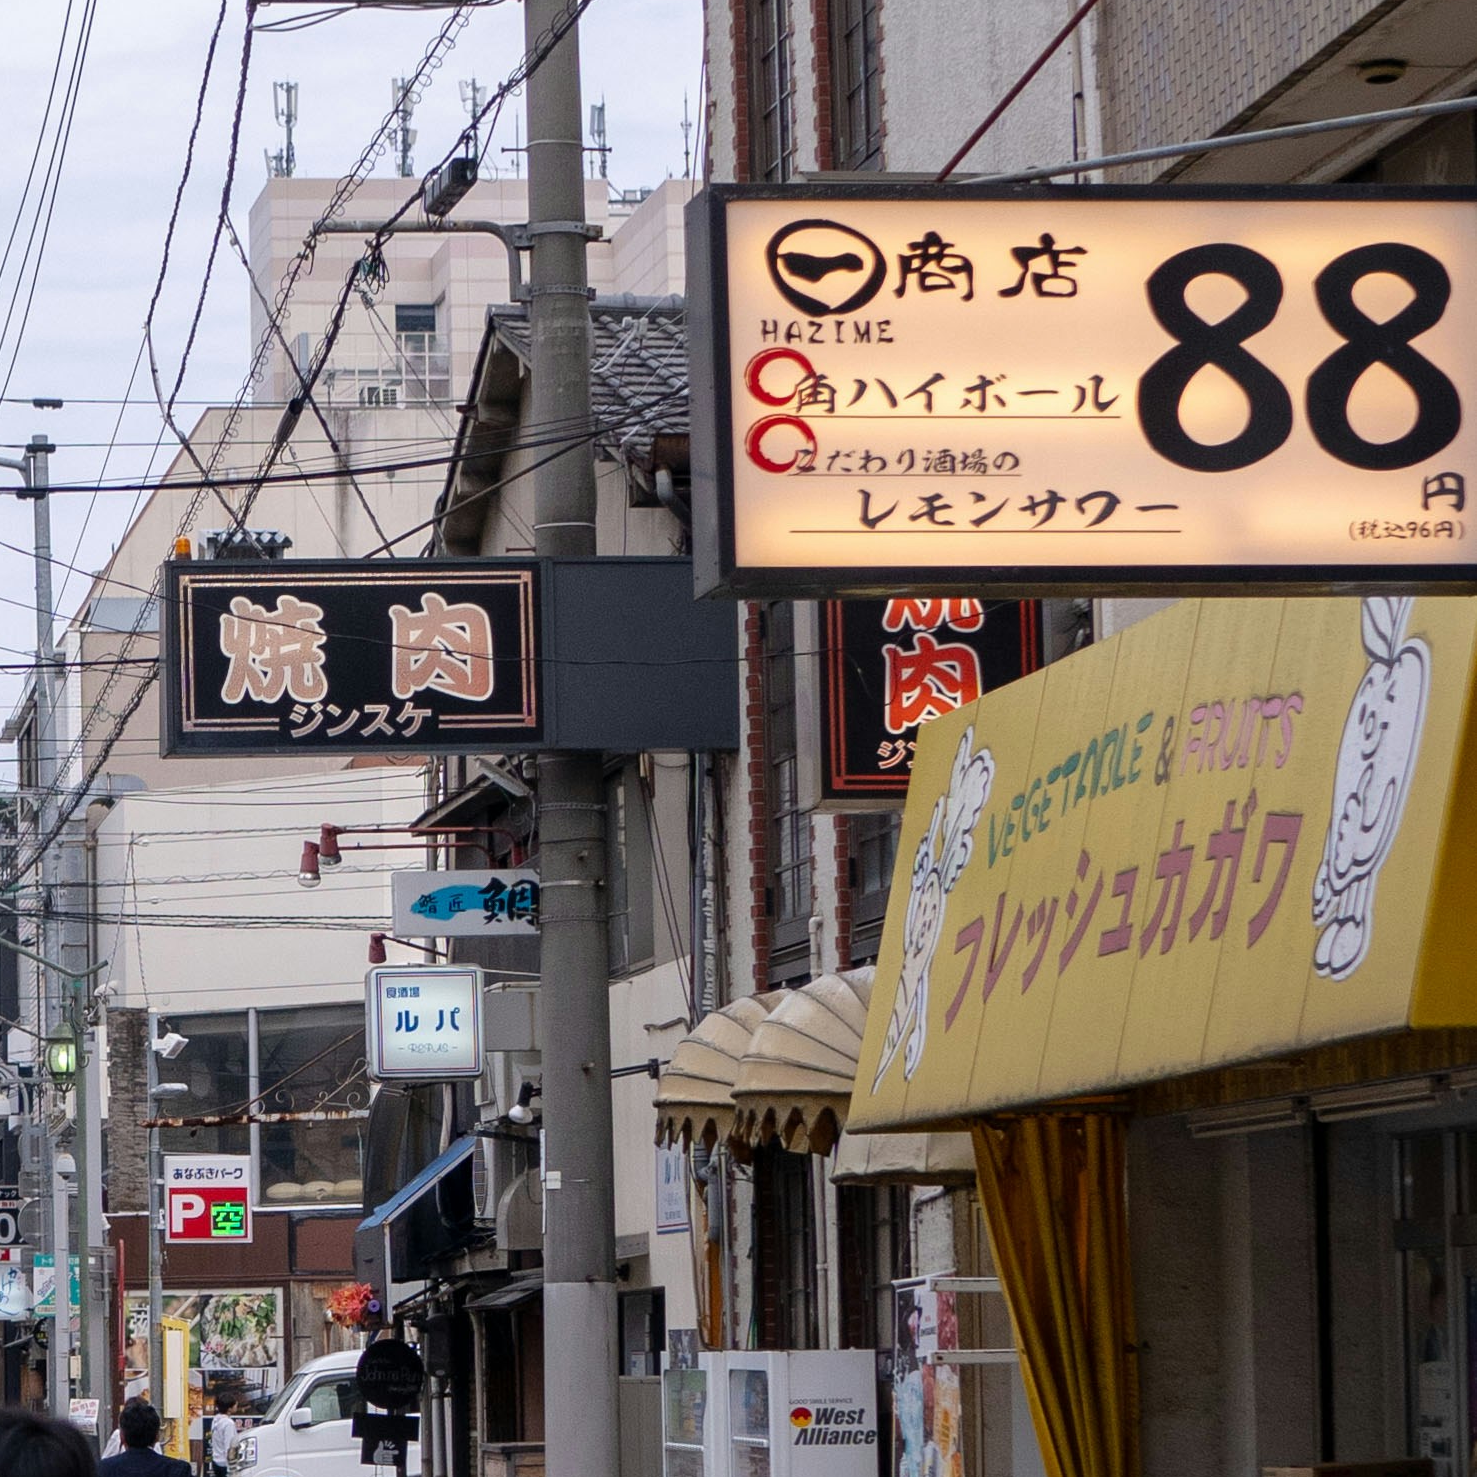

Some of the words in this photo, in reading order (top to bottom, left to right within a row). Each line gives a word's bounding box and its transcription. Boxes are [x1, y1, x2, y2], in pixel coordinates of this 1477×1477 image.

[761, 320, 895, 344] HAZIME
[1136, 242, 1462, 472] 88
[795, 371, 1121, 413] 角ハイボール
[795, 446, 1021, 476] こだわり酒場の
[858, 488, 1179, 529] レモンサワー
[1422, 471, 1465, 513] 円
[220, 593, 495, 704] 焼肉
[288, 702, 432, 737] ジンスケ
[988, 711, 1154, 869] VEGETABLE
[1179, 691, 1304, 776] FRUITS
[944, 787, 1304, 1033] フレッシュカガワ
[395, 1007, 460, 1032] ルパ
[173, 1168, 242, 1179] あなぶきパーク
[171, 1194, 205, 1232] P
[211, 1203, 244, 1236] 空
[794, 1427, 877, 1445] Alliance
[814, 1408, 865, 1425] West
